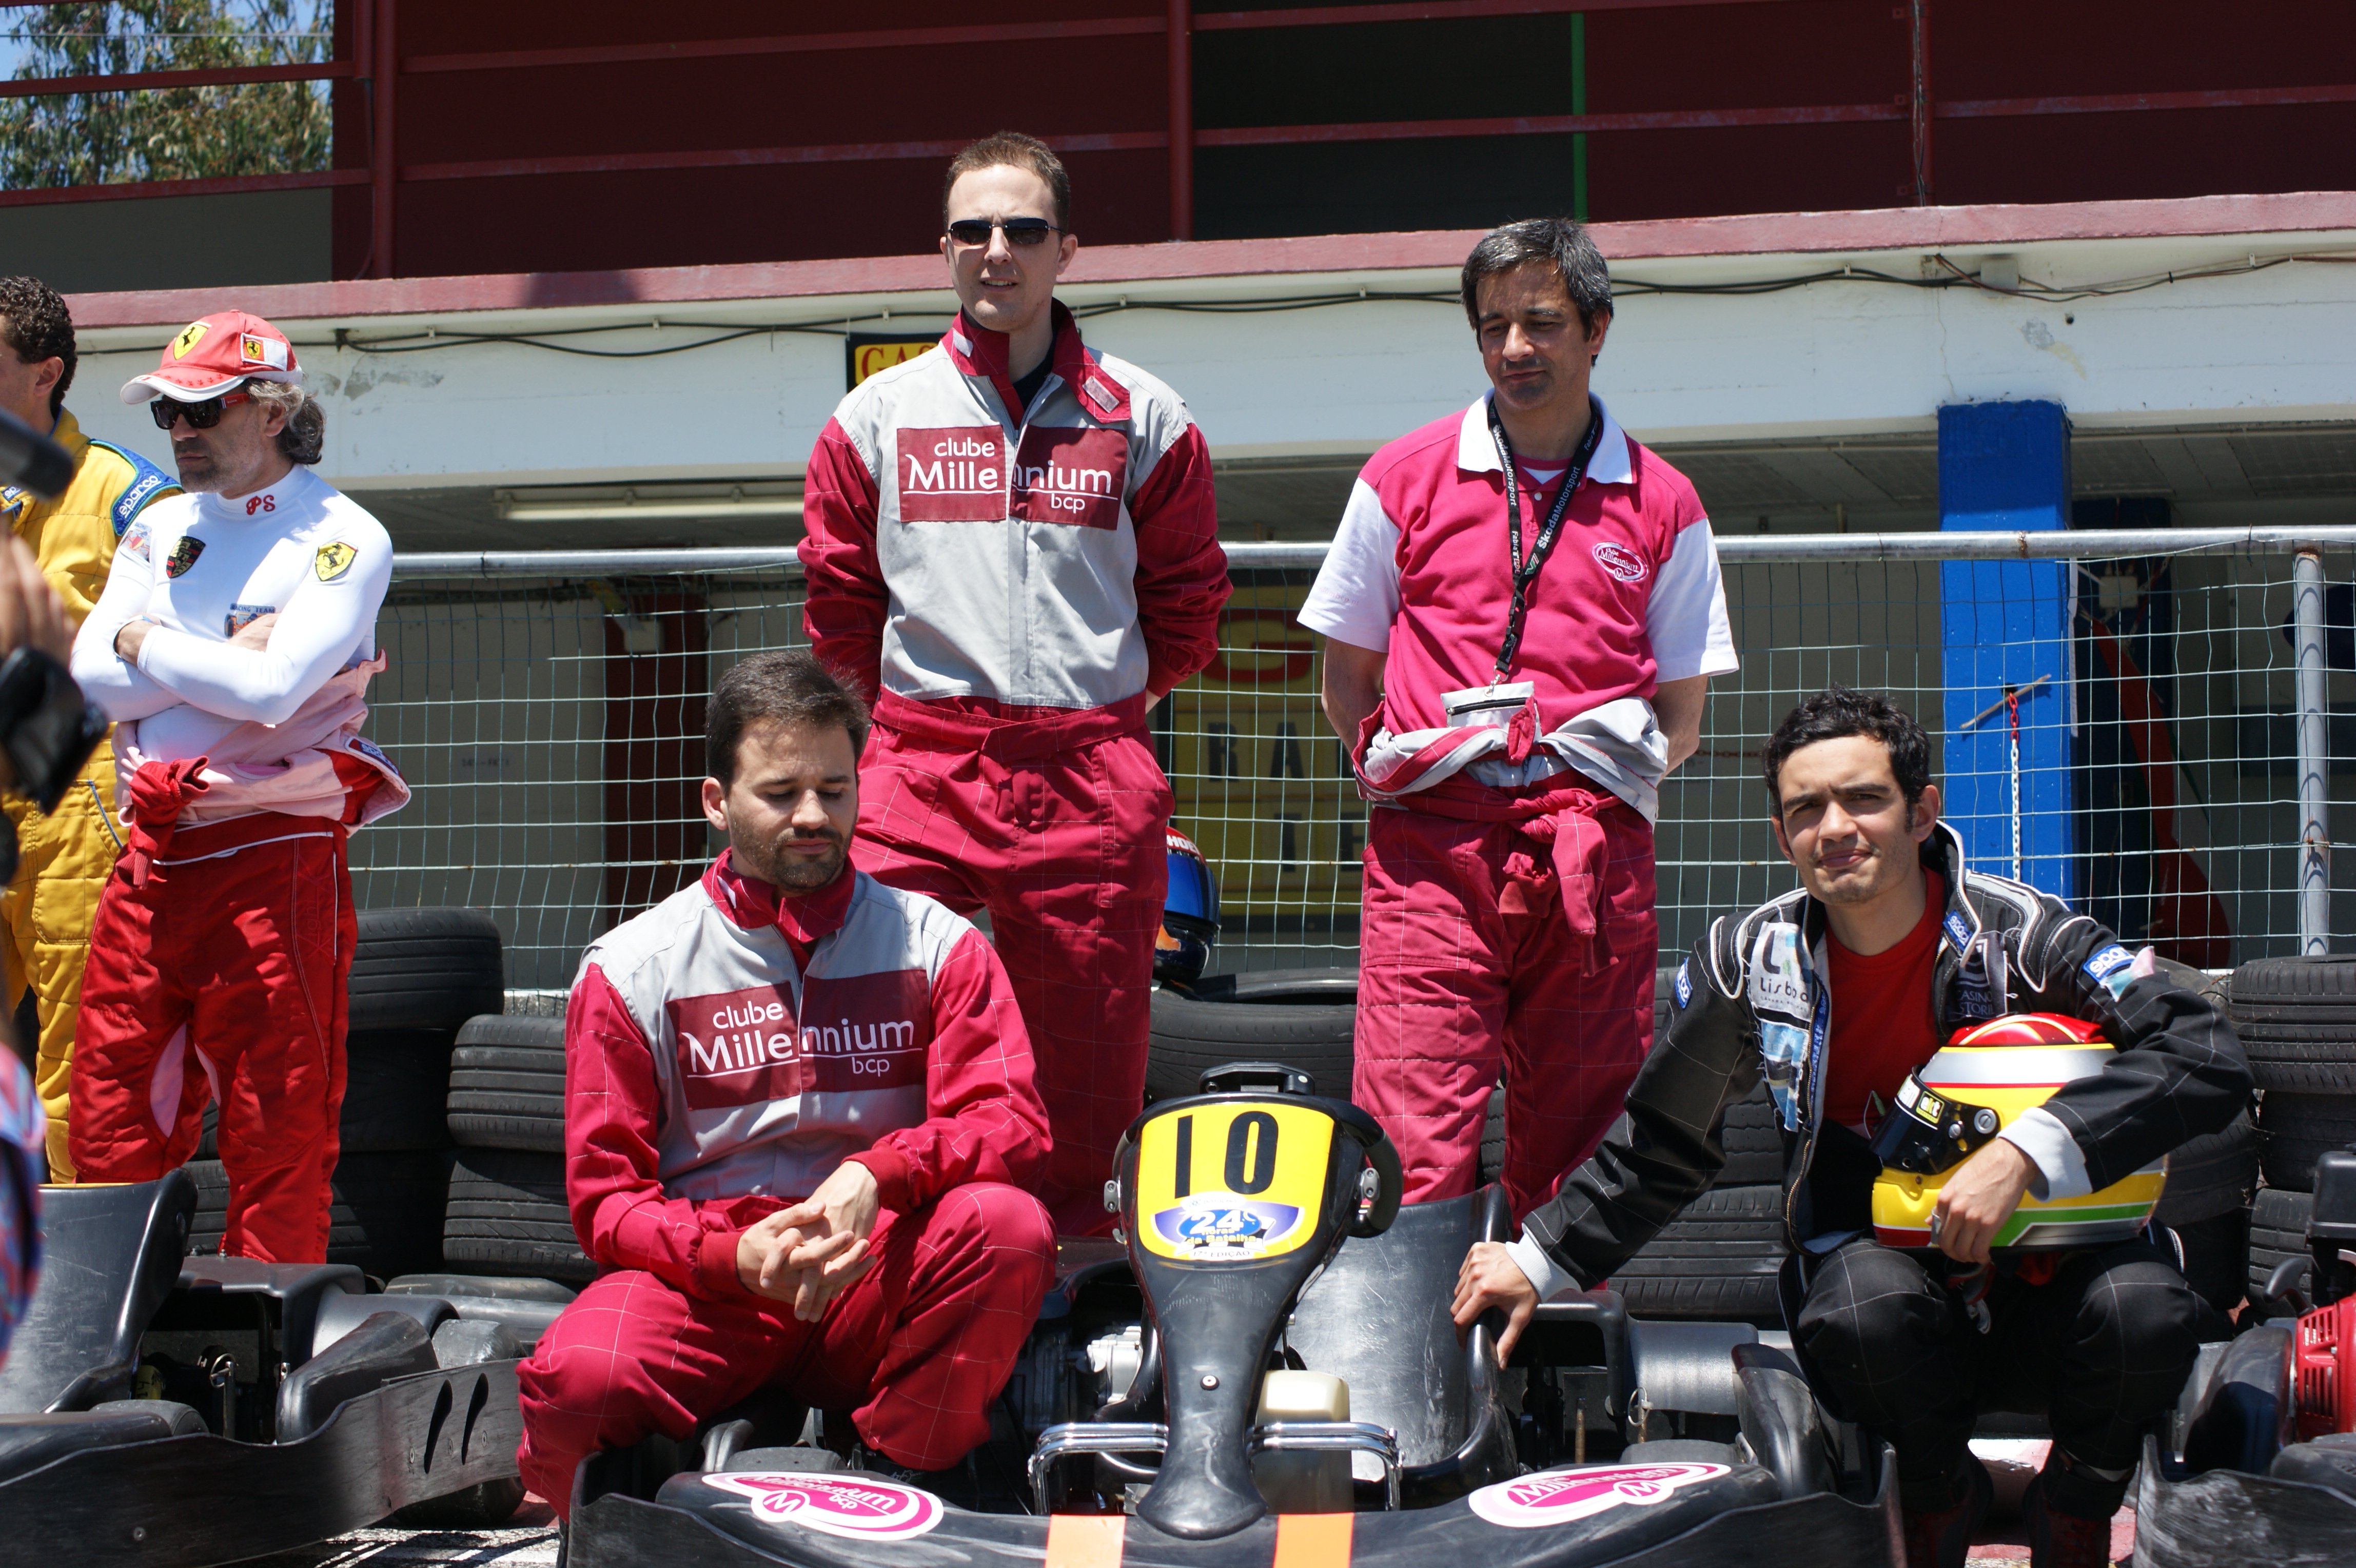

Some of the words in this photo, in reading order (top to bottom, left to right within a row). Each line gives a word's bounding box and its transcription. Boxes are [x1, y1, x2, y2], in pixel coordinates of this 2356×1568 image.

[861, 345, 934, 379] GA
[934, 437, 995, 458] clube
[119, 475, 161, 518] sparco
[1051, 493, 1086, 514] bcp
[1600, 549, 1638, 571] Millennium
[231, 604, 251, 612] RACING
[2089, 947, 2130, 976] spar
[1760, 977, 1809, 1003] Lisboa
[1957, 990, 1992, 1003] ASINO
[713, 1001, 783, 1029] clube
[1959, 1002, 1995, 1015] STORIL
[851, 1056, 890, 1077] bcp
[1174, 1110, 1279, 1199] 10
[1190, 1210, 1244, 1235] 24
[1206, 1234, 1256, 1244] Batalha
[828, 1494, 858, 1510] bcp
